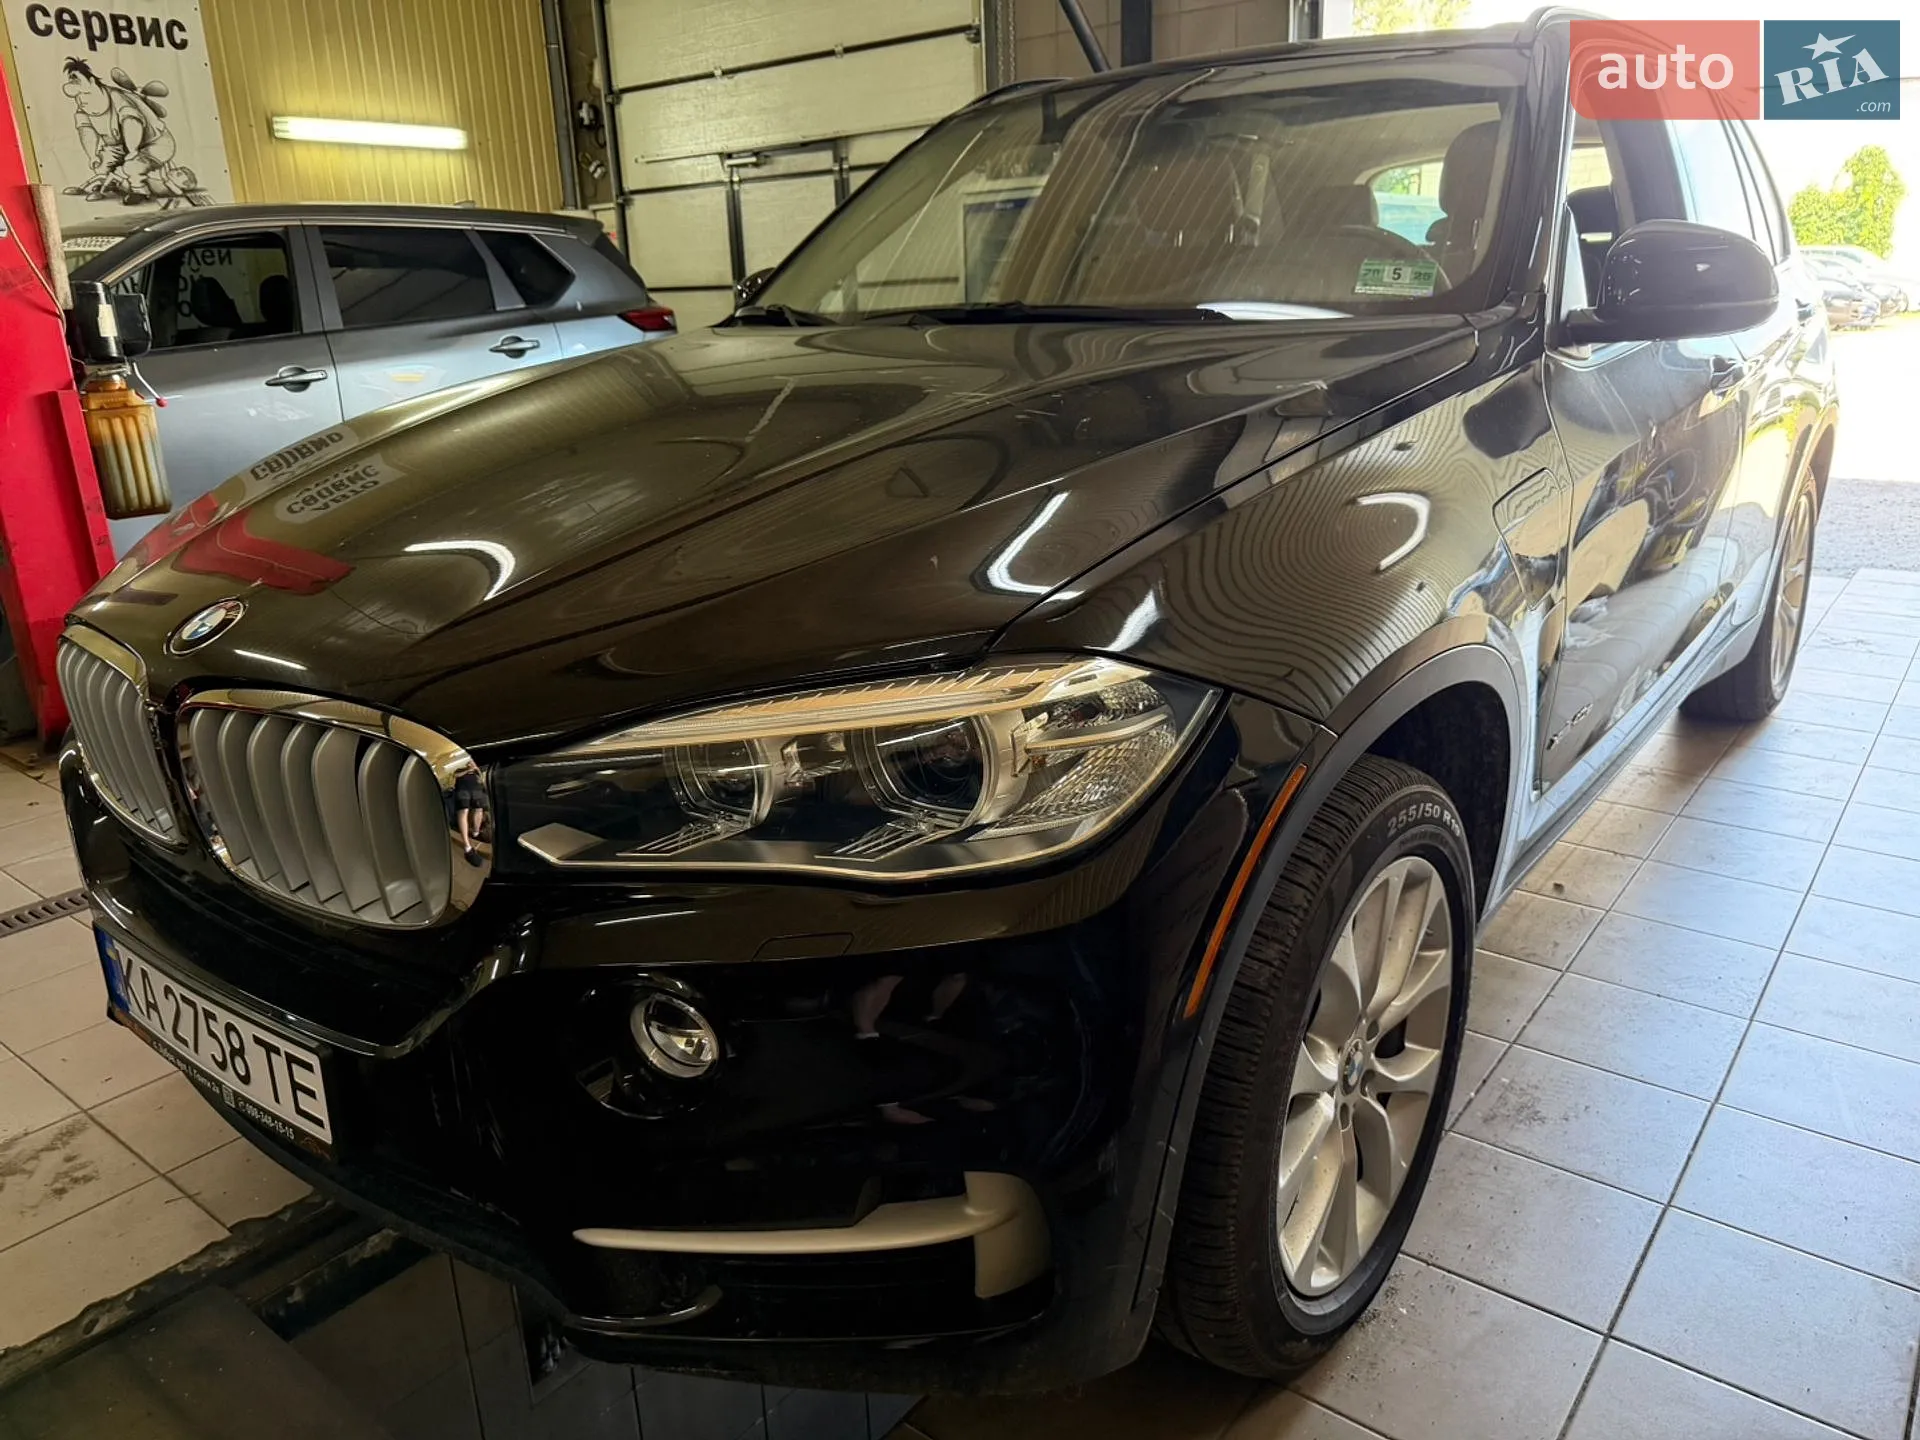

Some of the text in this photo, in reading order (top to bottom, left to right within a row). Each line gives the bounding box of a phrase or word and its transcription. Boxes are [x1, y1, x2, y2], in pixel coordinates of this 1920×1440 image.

[25, 3, 189, 51] сервис
[1391, 267, 1403, 281] 5
[1387, 802, 1441, 838] 255/50
[116, 949, 326, 1130] KA 2758 TE
